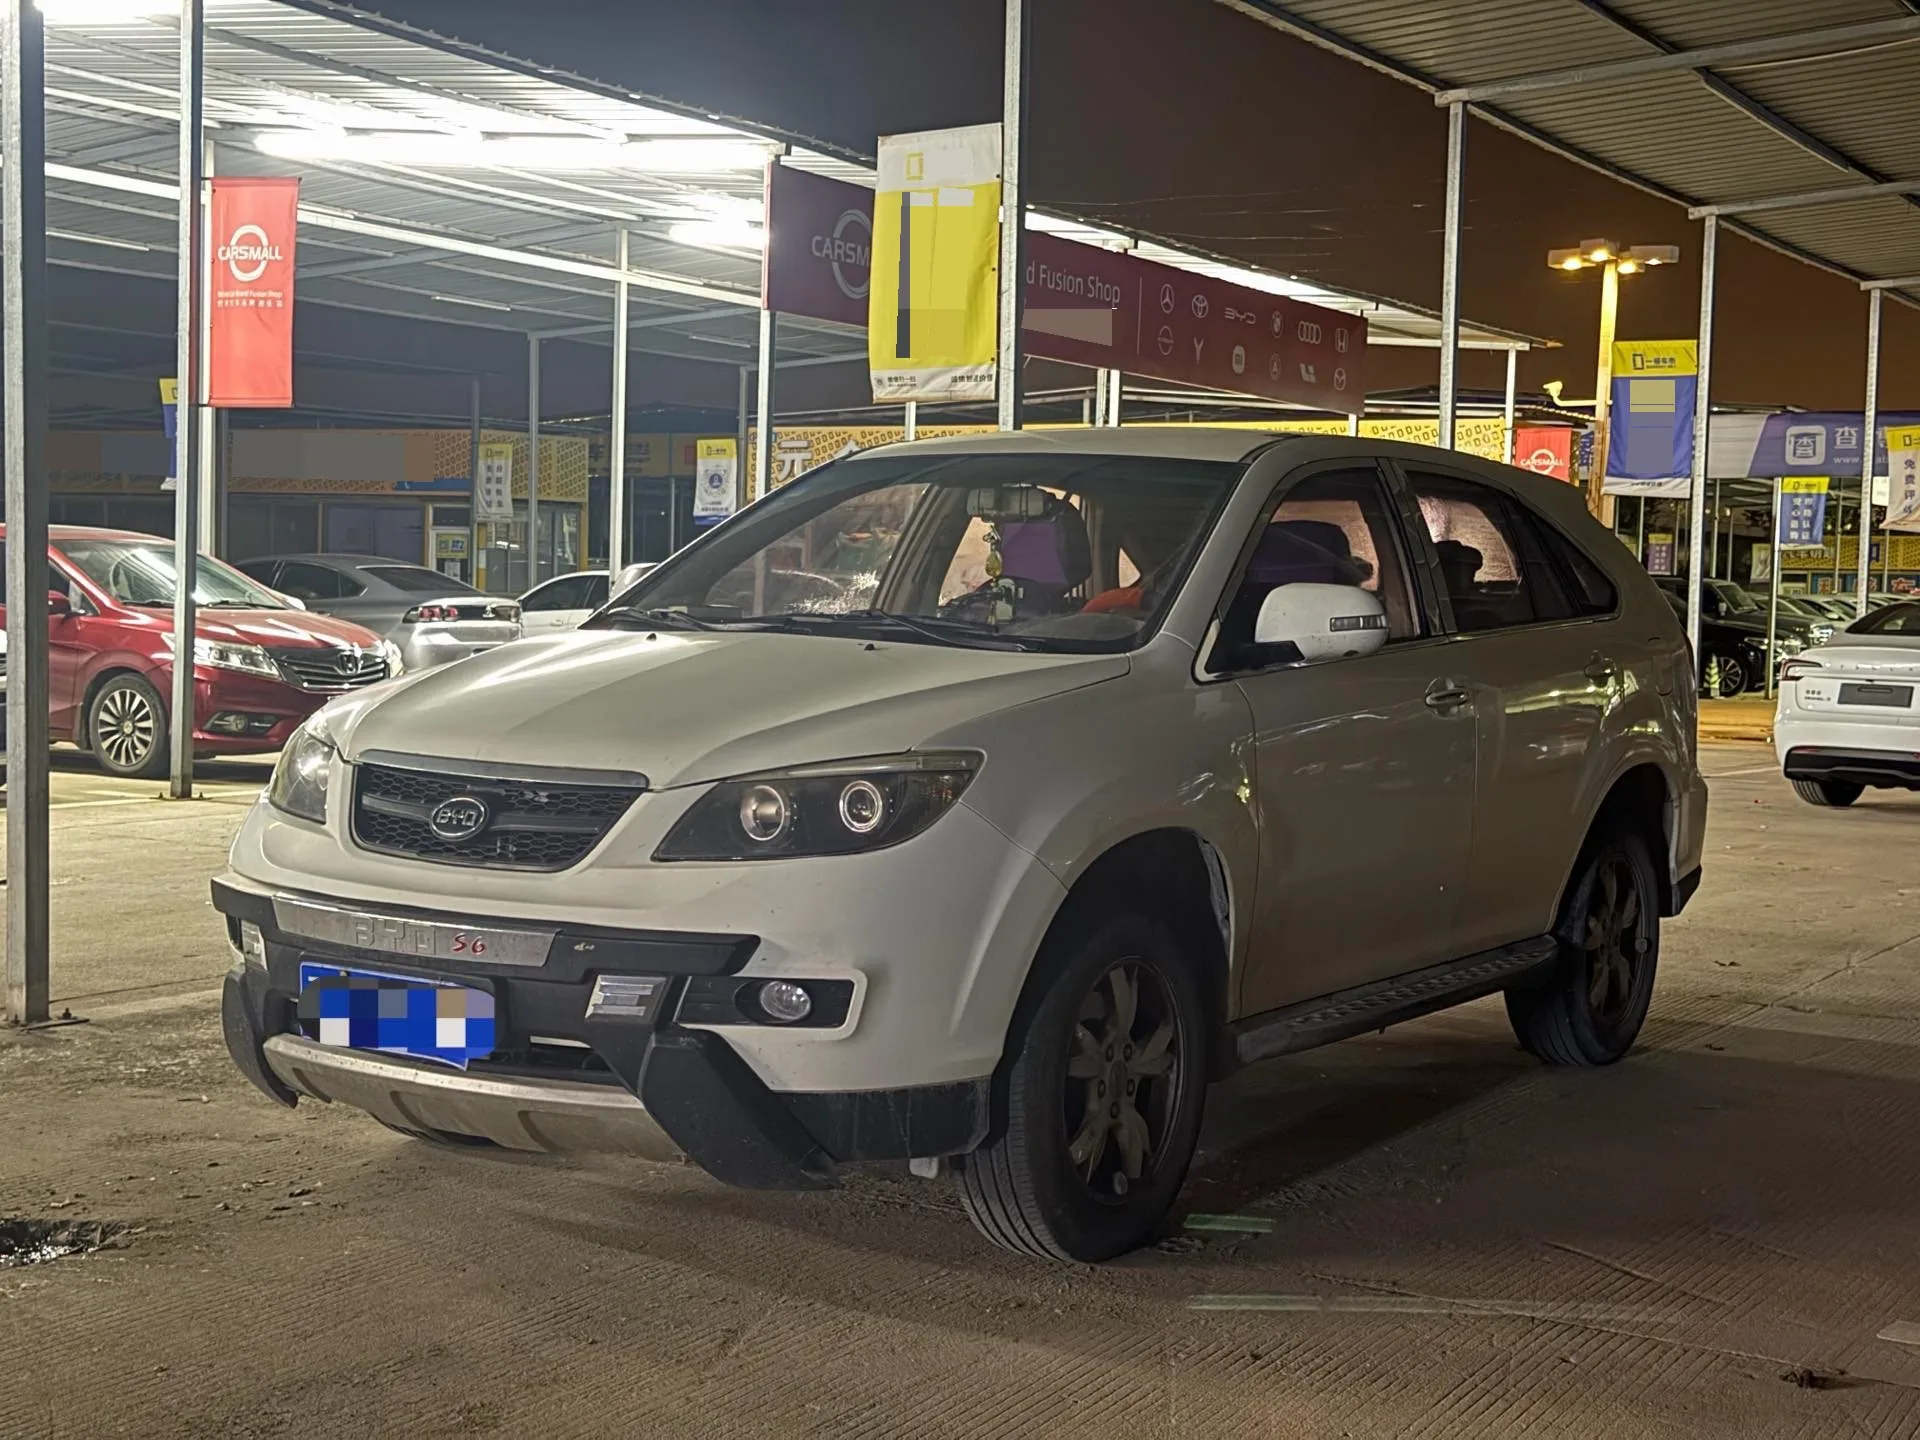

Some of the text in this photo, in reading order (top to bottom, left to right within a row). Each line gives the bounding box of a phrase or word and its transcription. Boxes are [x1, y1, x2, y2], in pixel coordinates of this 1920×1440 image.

[217, 245, 284, 261] CARSMALL
[812, 235, 870, 267] CARSM
[1039, 264, 1084, 296] Fusion
[1087, 275, 1121, 308] Shop
[1520, 457, 1565, 467] CARSMALL
[436, 809, 477, 826] BYD
[353, 917, 486, 955] BYD S6
